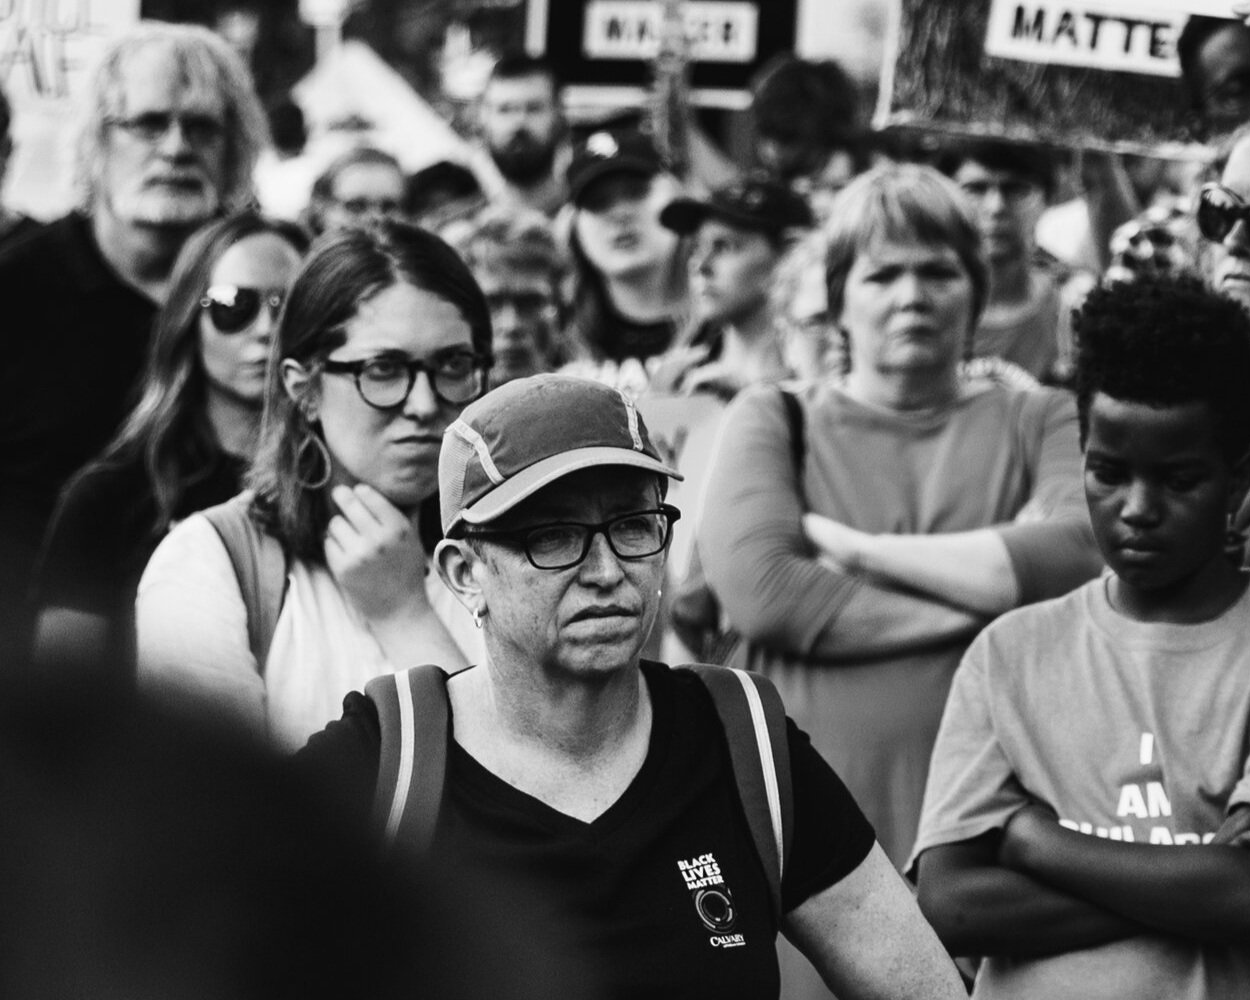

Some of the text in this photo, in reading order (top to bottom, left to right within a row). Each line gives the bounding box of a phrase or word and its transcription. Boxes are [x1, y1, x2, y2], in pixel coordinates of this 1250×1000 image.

[1012, 4, 1171, 59] MATTE
[1140, 732, 1154, 764] I
[677, 853, 716, 871] BLACK
[682, 863, 721, 882] LIVES
[687, 875, 724, 890] MATTER
